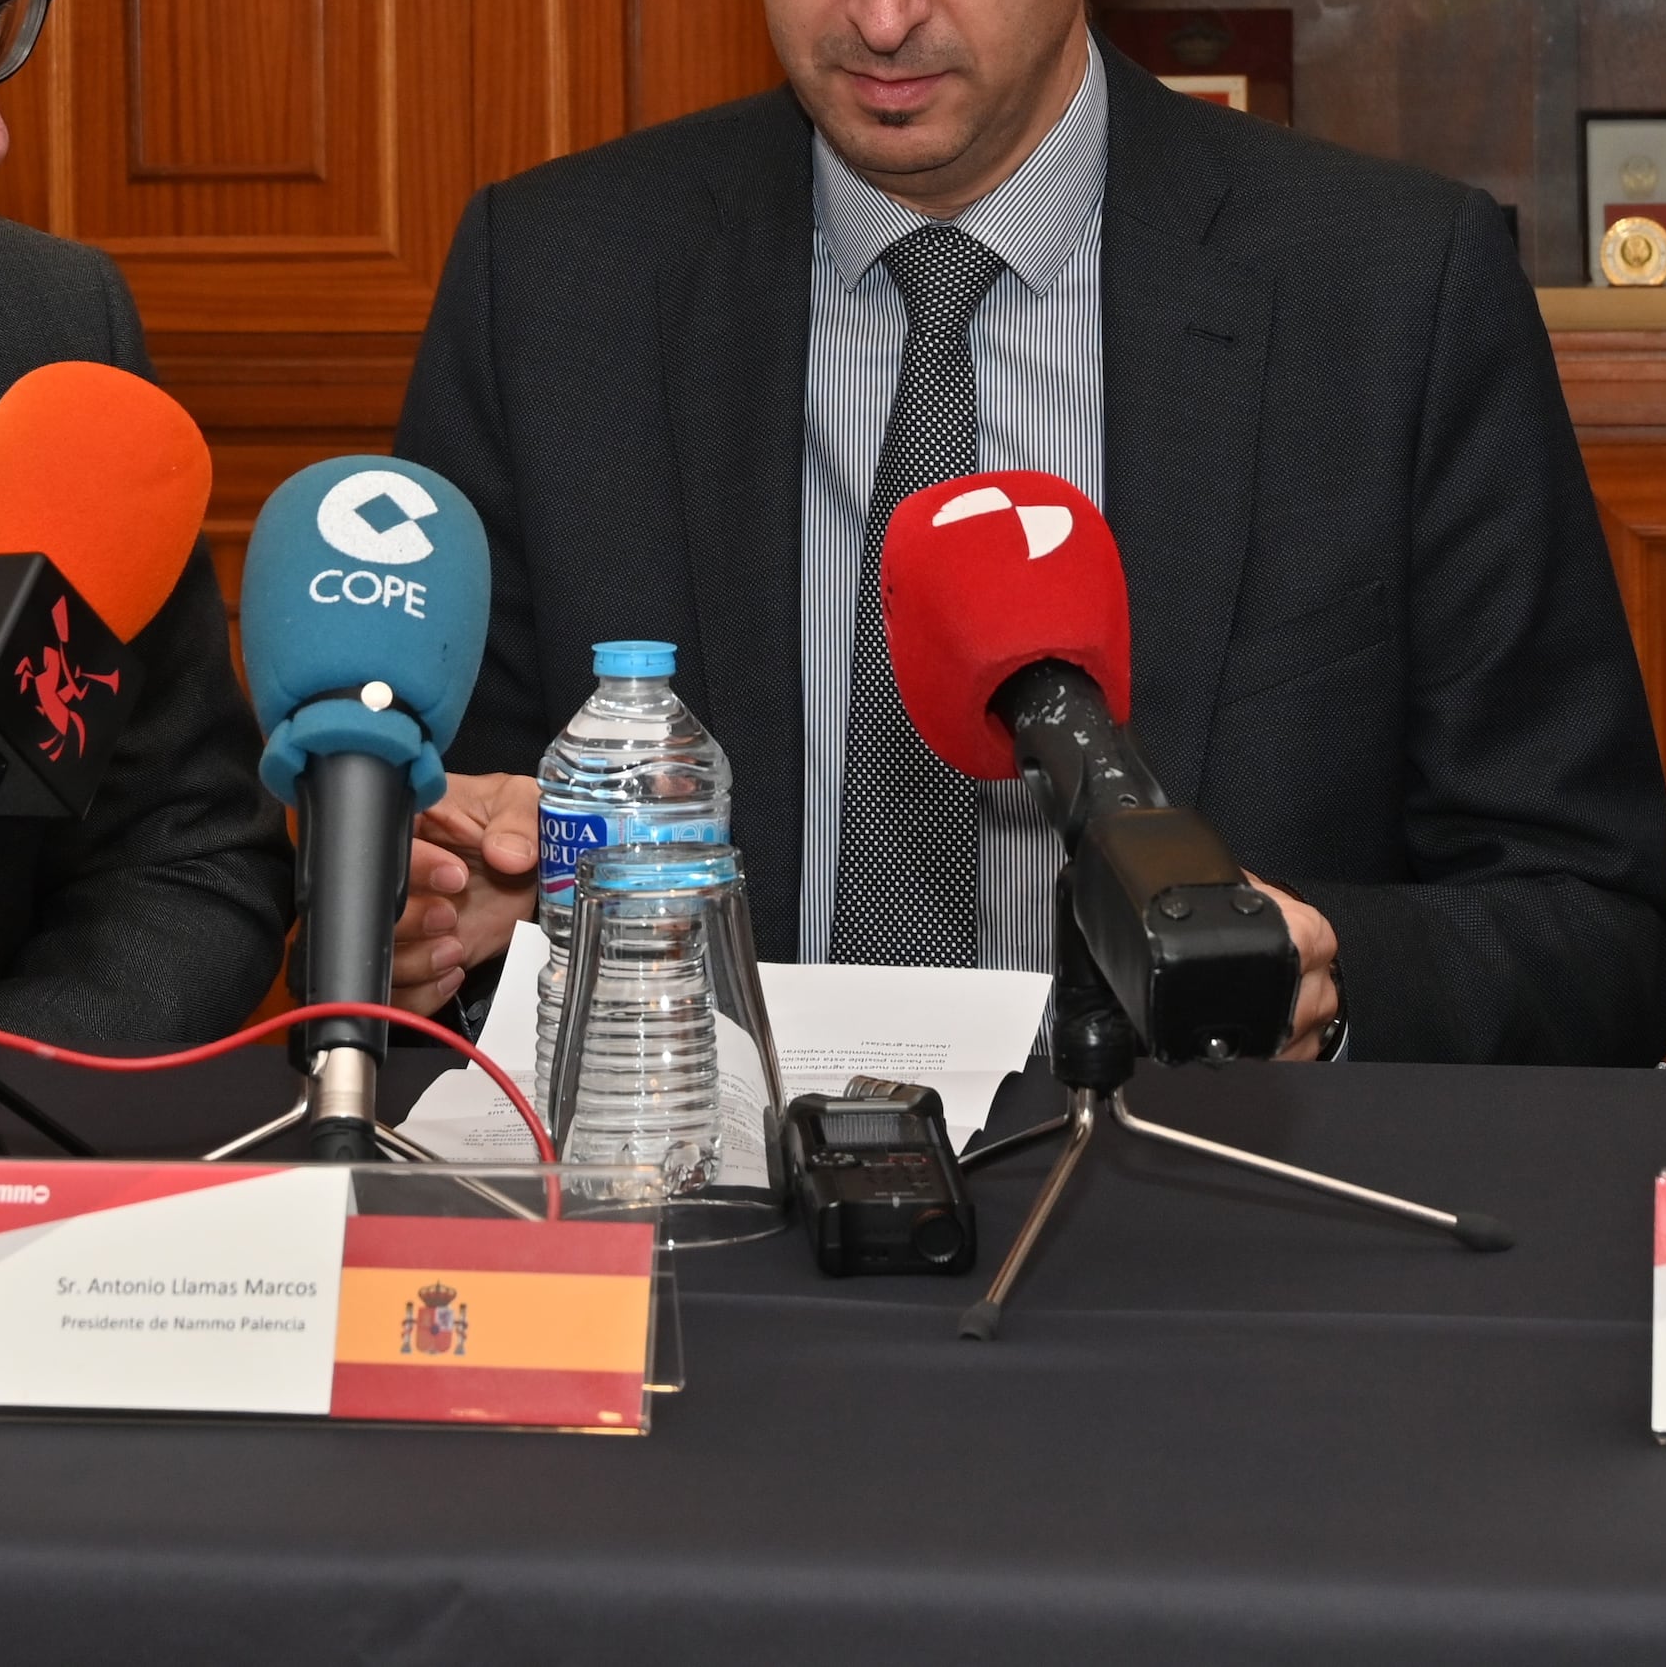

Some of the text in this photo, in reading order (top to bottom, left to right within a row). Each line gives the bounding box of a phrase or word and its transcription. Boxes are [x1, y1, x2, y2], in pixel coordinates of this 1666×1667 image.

[308, 568, 427, 620] COPE
[56, 1277, 318, 1298] Sr. Antonio Llamas Marcos
[60, 1314, 307, 1333] Presidente de Nammo Palencia
